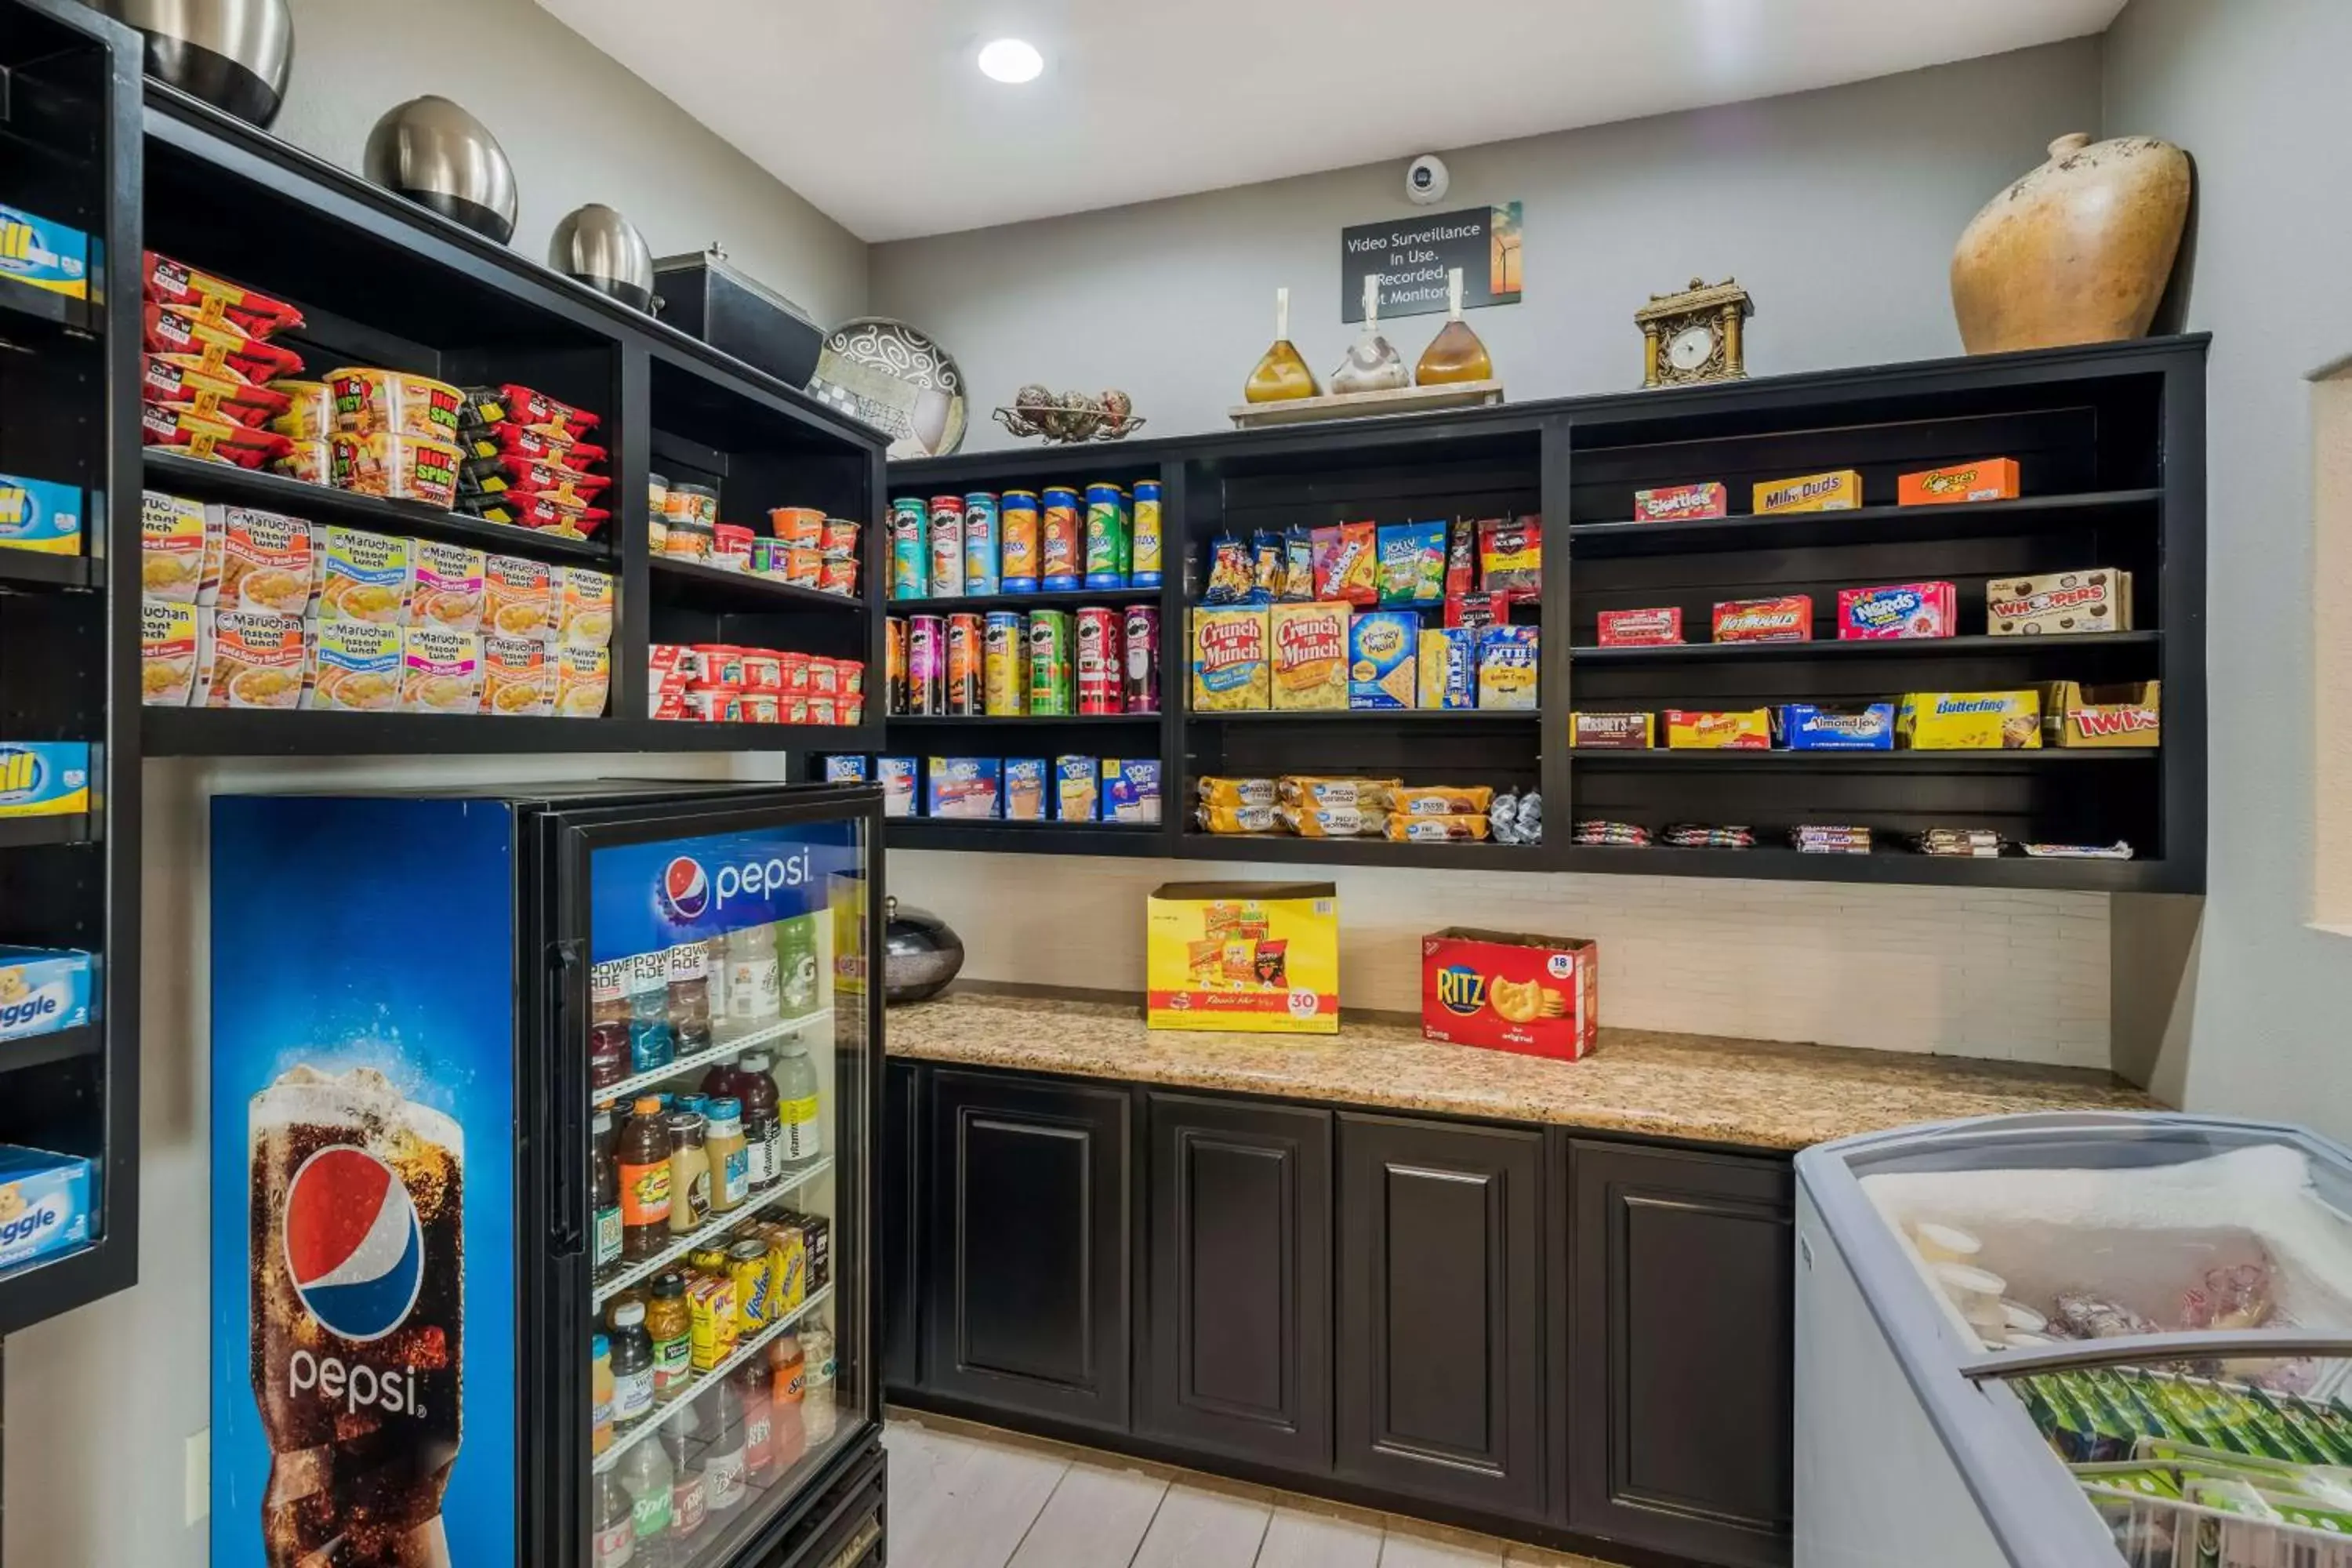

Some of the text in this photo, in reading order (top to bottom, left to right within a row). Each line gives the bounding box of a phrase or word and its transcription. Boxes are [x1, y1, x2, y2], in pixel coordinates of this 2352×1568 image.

[1347, 224, 1481, 254] Video Surveillance
[1390, 250, 1439, 267] In Use.
[1802, 476, 1840, 499] Duds
[1647, 492, 1711, 515] Skittles
[242, 514, 307, 535] Maruchan
[248, 527, 292, 541] Instant
[252, 537, 288, 550] Lunch
[344, 535, 402, 553] Maruchan
[349, 547, 390, 561] Instant
[353, 557, 384, 568] Lunch
[430, 547, 480, 564] Maruchan
[499, 560, 548, 577] Maruchan
[143, 605, 189, 621] uchan
[234, 614, 301, 631] Maruchan
[336, 623, 395, 639] Maruchan
[1277, 615, 1340, 646] Crunch
[239, 628, 285, 641] Instant
[421, 630, 471, 646] Maruchan
[1200, 618, 1260, 648] Crunch
[245, 636, 280, 648] Lunch
[341, 637, 383, 648] Instant
[346, 645, 377, 655] Lunch
[1205, 641, 1261, 673] Munch
[1283, 639, 1341, 670] Munch
[1936, 697, 2007, 715] Butterfing
[1811, 716, 1857, 730] Almond
[716, 845, 810, 910] pepsi
[671, 956, 700, 970] ADE
[1554, 957, 1567, 968] 18
[634, 966, 666, 980] ADE
[1436, 968, 1486, 1007] RITZ
[1290, 993, 1315, 1008] 30
[0, 995, 56, 1028] ggle
[0, 1207, 56, 1246] ggle
[289, 1349, 416, 1416] pepsi
